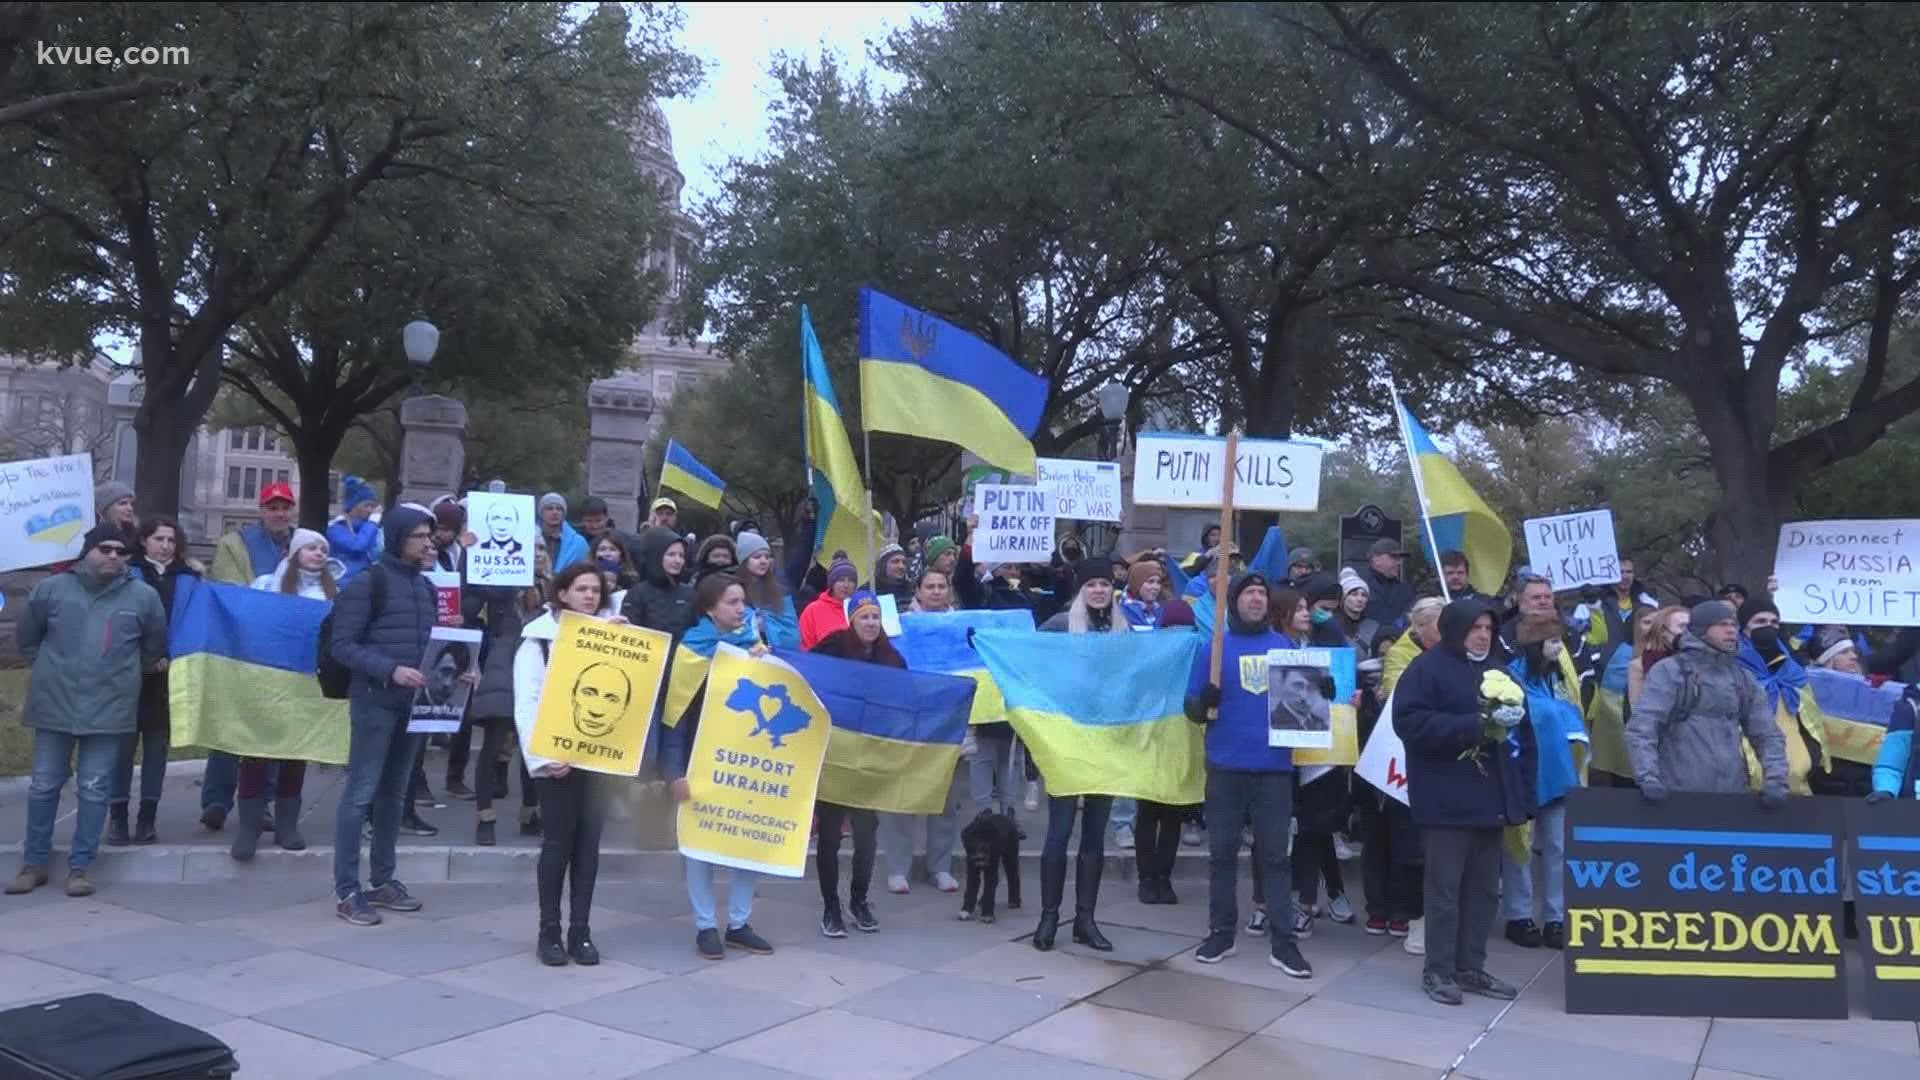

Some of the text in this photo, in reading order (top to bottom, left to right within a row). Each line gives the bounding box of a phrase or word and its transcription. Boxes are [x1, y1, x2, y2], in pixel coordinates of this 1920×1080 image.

[1156, 450, 1294, 488] PUTIN KILLS
[983, 488, 1046, 513] PUTIN
[1086, 501, 1116, 518] WAR
[990, 514, 1051, 531] BACK OFF
[988, 534, 1050, 552] UKRAINE
[1788, 528, 1905, 549] Disconnect
[473, 554, 526, 567] RUSSIA
[575, 638, 650, 664] SANCTIONS
[577, 626, 653, 651] APPLY REAL
[551, 735, 625, 760] TO PUTIN
[715, 748, 795, 777] SUPPORT
[713, 769, 791, 798] UKRAINE
[693, 801, 798, 832] SAVE DEMOCRACY
[698, 819, 713, 831] IN
[715, 821, 739, 837] THE
[1566, 851, 1840, 895] we defend
[1567, 908, 1841, 955] FREEDOM
